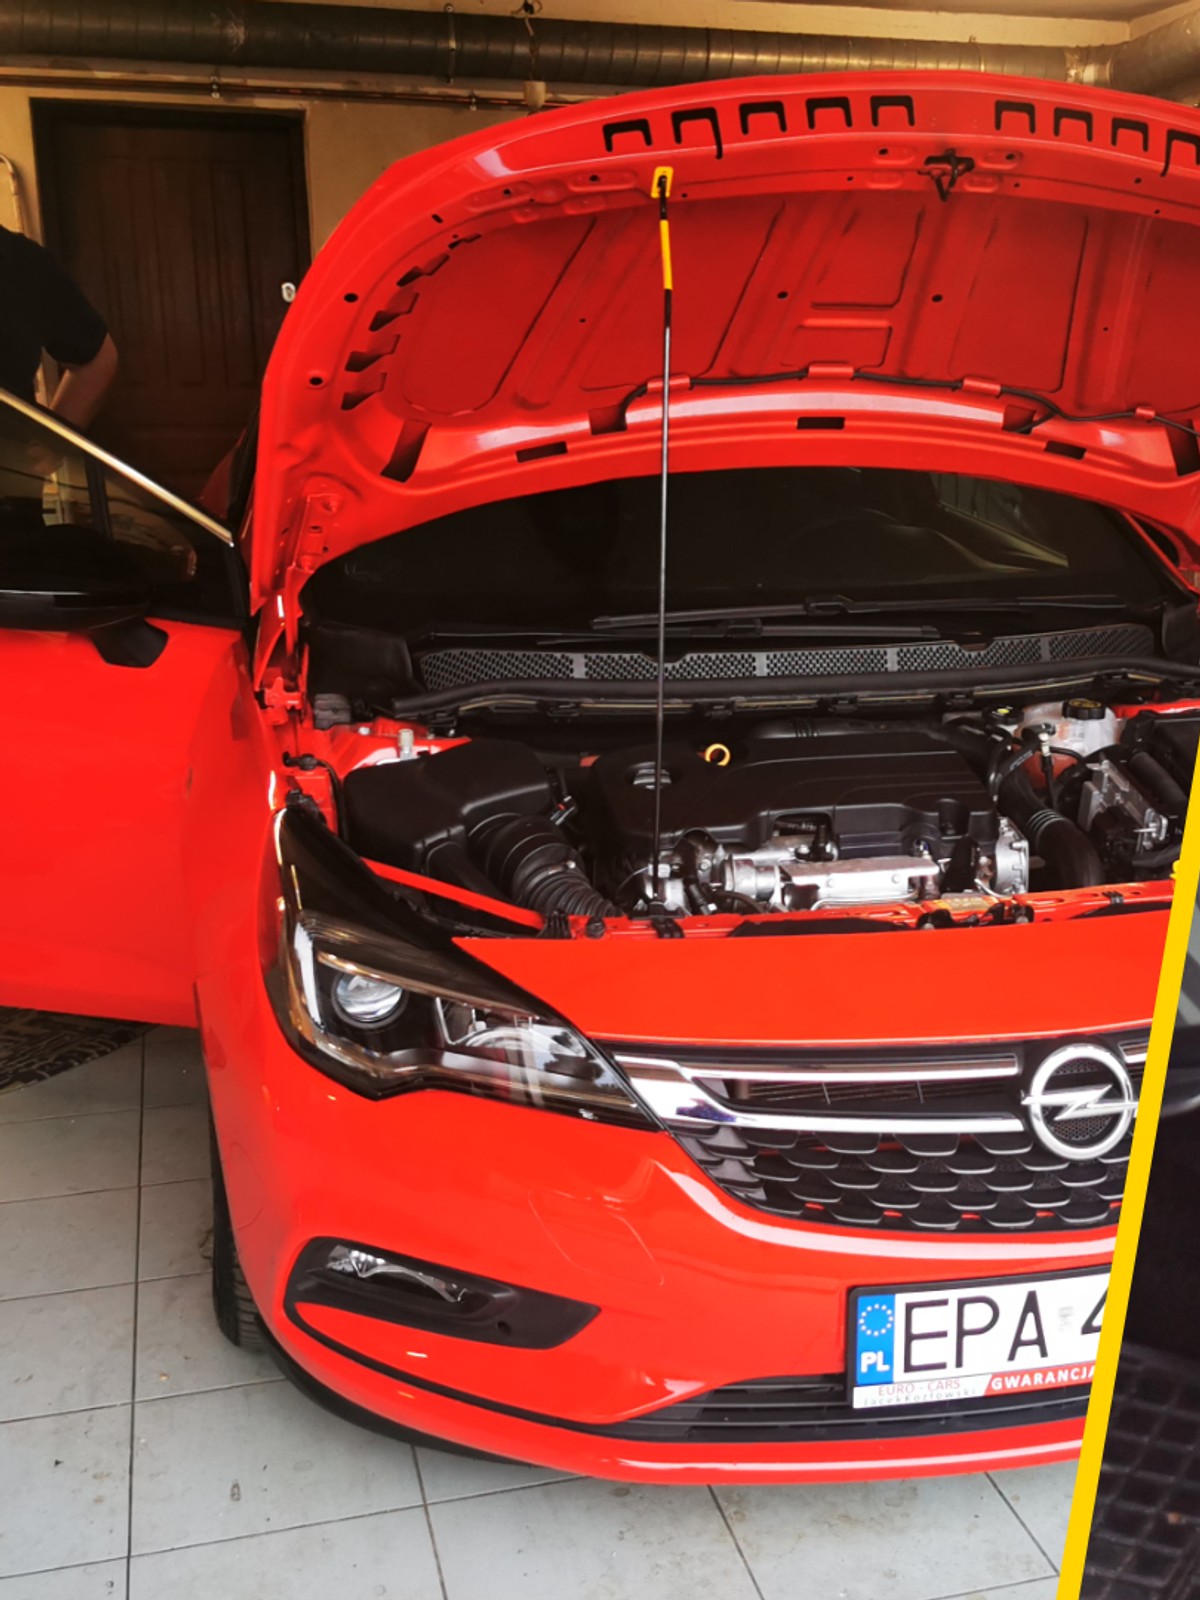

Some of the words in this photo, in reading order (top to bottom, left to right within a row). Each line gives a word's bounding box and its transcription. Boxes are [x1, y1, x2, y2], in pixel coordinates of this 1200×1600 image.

[903, 1290, 1049, 1373] EPA
[860, 1351, 890, 1373] PL
[878, 1383, 915, 1396] EURO
[927, 1379, 960, 1392] CARS
